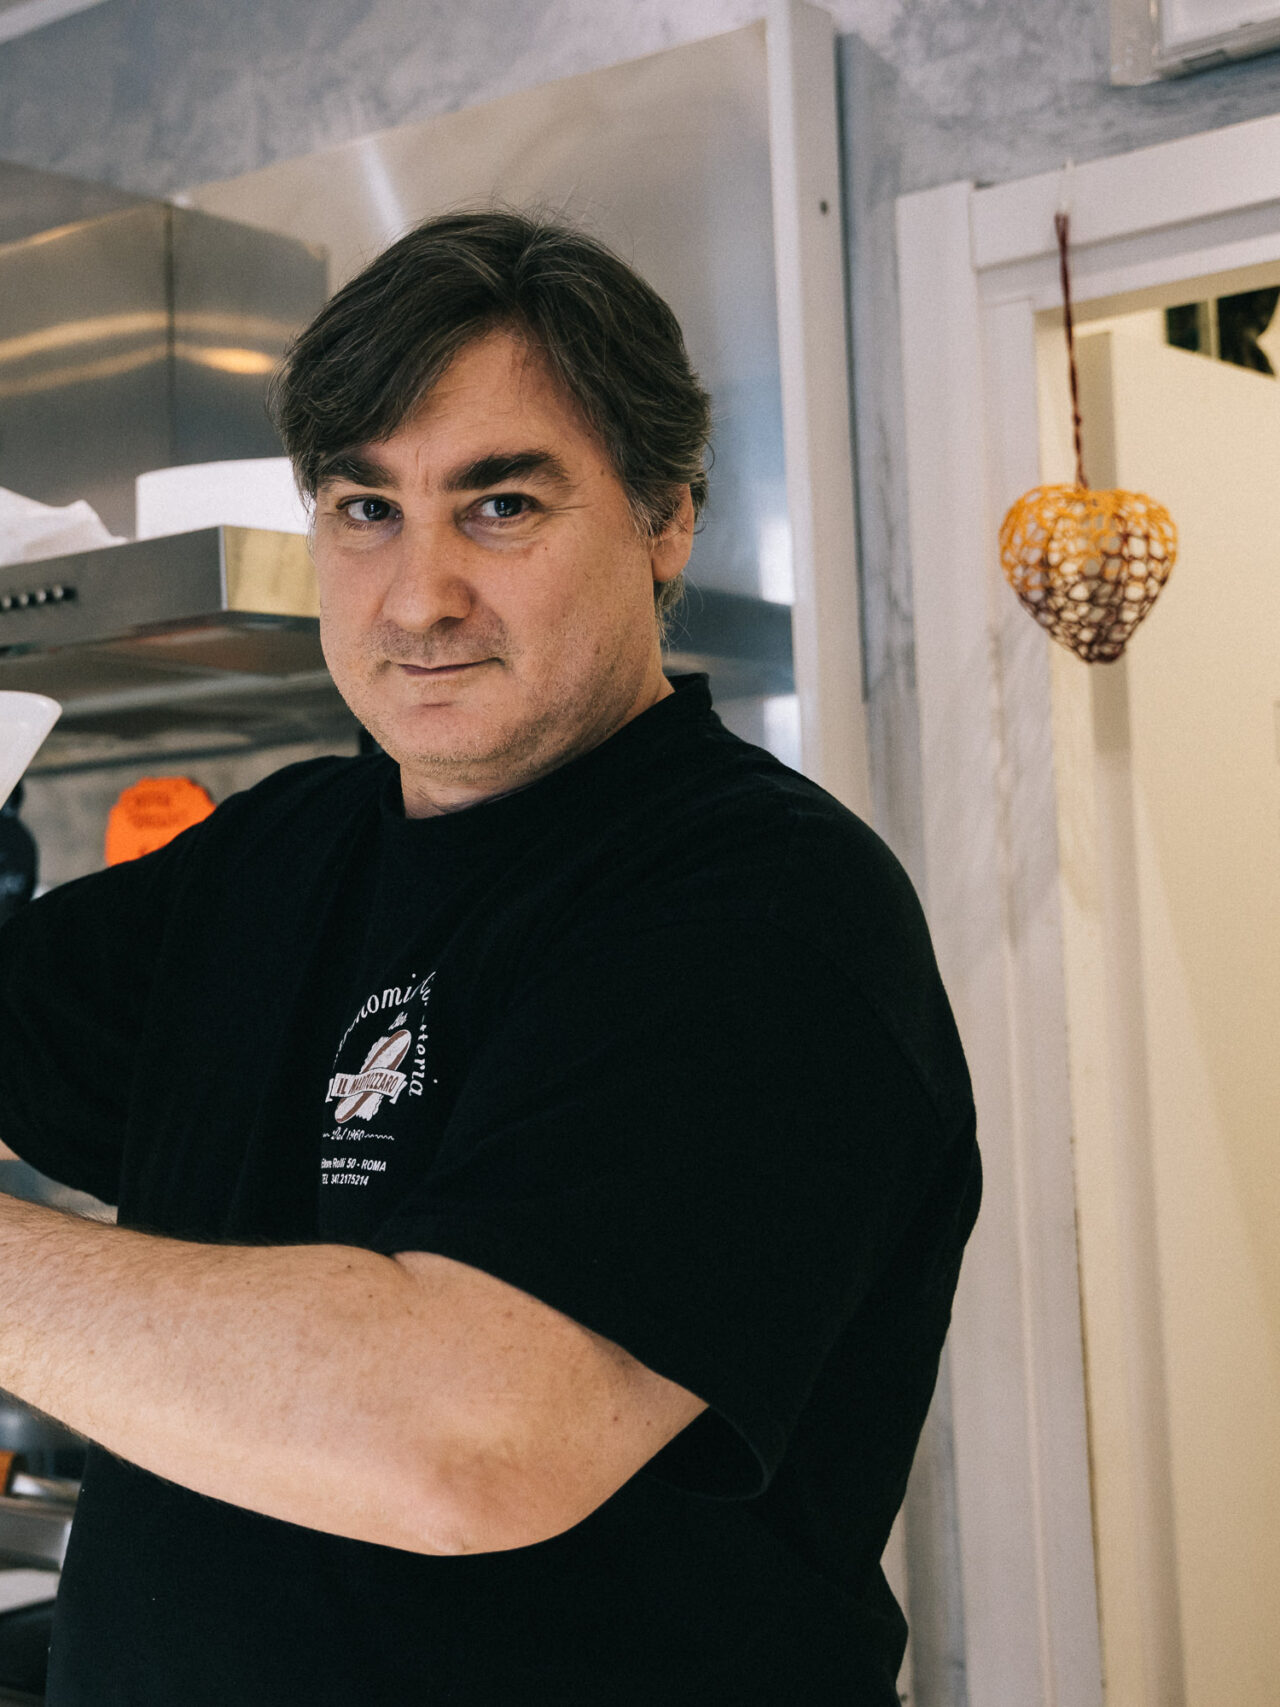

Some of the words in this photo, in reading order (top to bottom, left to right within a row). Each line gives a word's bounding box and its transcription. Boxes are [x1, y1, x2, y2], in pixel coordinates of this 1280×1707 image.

[336, 1077, 349, 1095] IL
[346, 1157, 357, 1169] 50
[361, 1158, 387, 1172] ROMA
